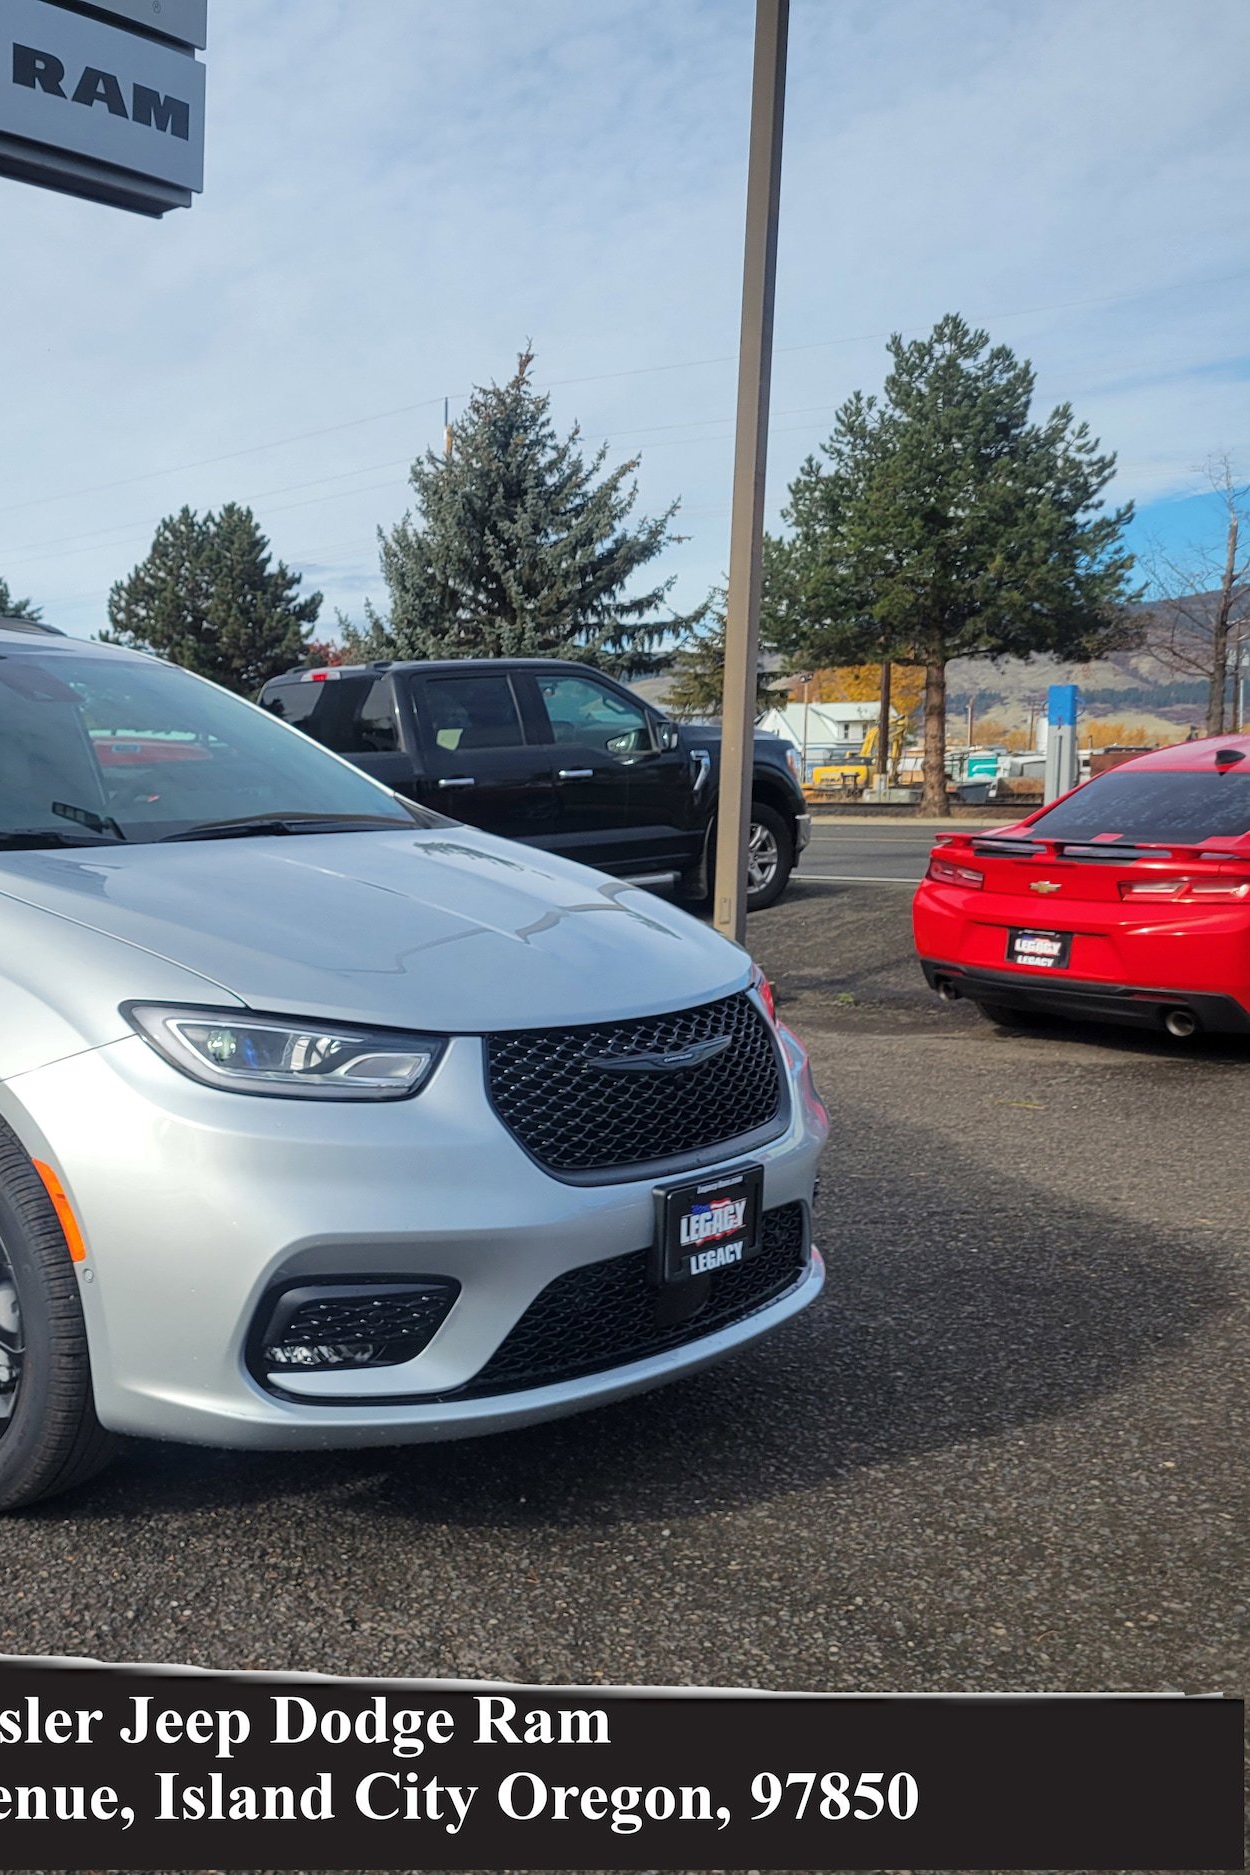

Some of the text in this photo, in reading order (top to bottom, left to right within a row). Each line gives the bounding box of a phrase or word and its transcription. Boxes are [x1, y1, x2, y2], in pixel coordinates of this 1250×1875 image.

[12, 42, 190, 141] RAM
[680, 1200, 747, 1245] LEGACY
[690, 1240, 743, 1276] LEGACY
